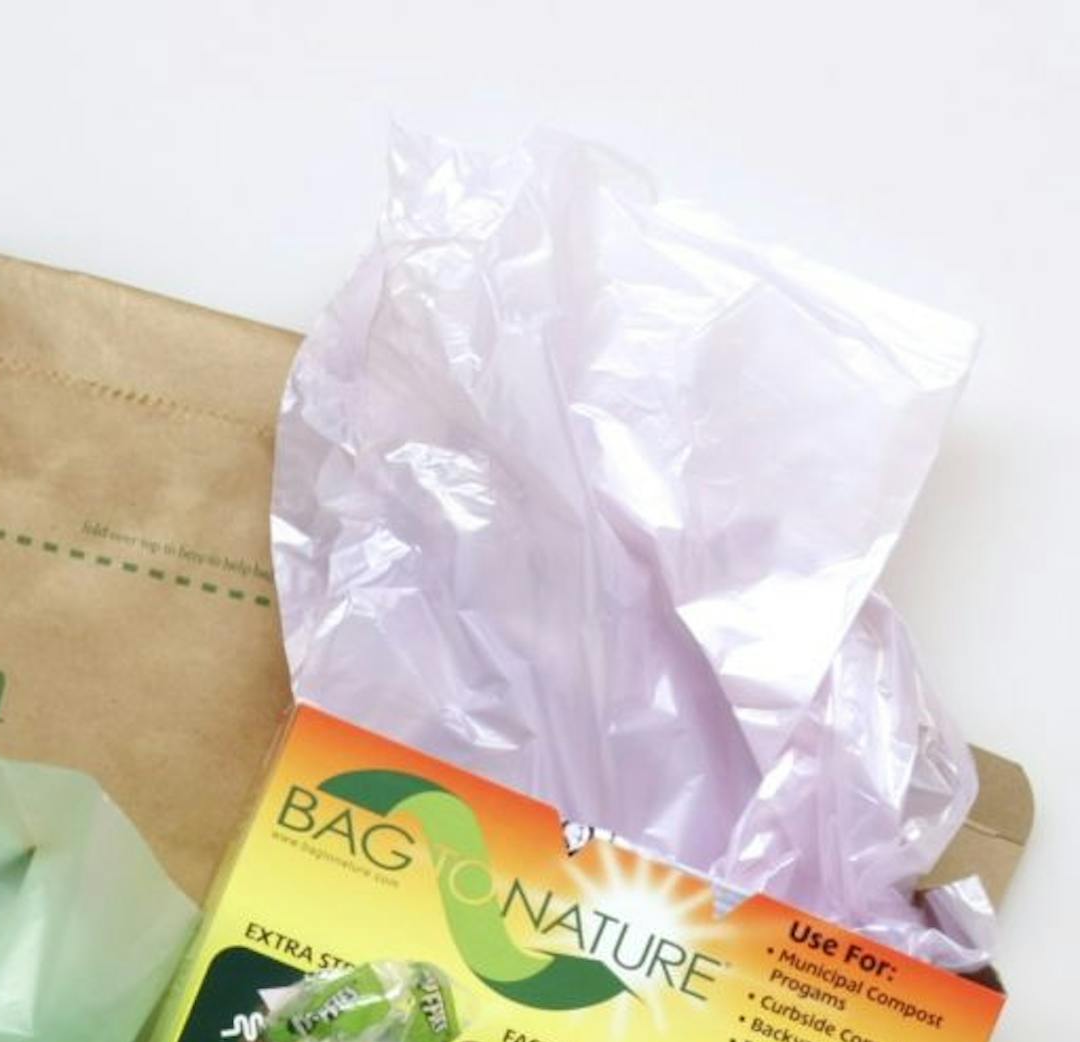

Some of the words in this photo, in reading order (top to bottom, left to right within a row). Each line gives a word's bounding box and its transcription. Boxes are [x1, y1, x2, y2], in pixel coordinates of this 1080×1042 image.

[276, 785, 415, 873] BAG
[499, 877, 726, 1001] NATURE
[244, 921, 314, 965] EXTRA
[789, 921, 838, 957] Use
[844, 944, 899, 983] For:
[760, 994, 837, 1037] Curbside
[770, 968, 847, 1012] Progams
[779, 949, 863, 994] Municipal
[866, 986, 945, 1030] Compost
